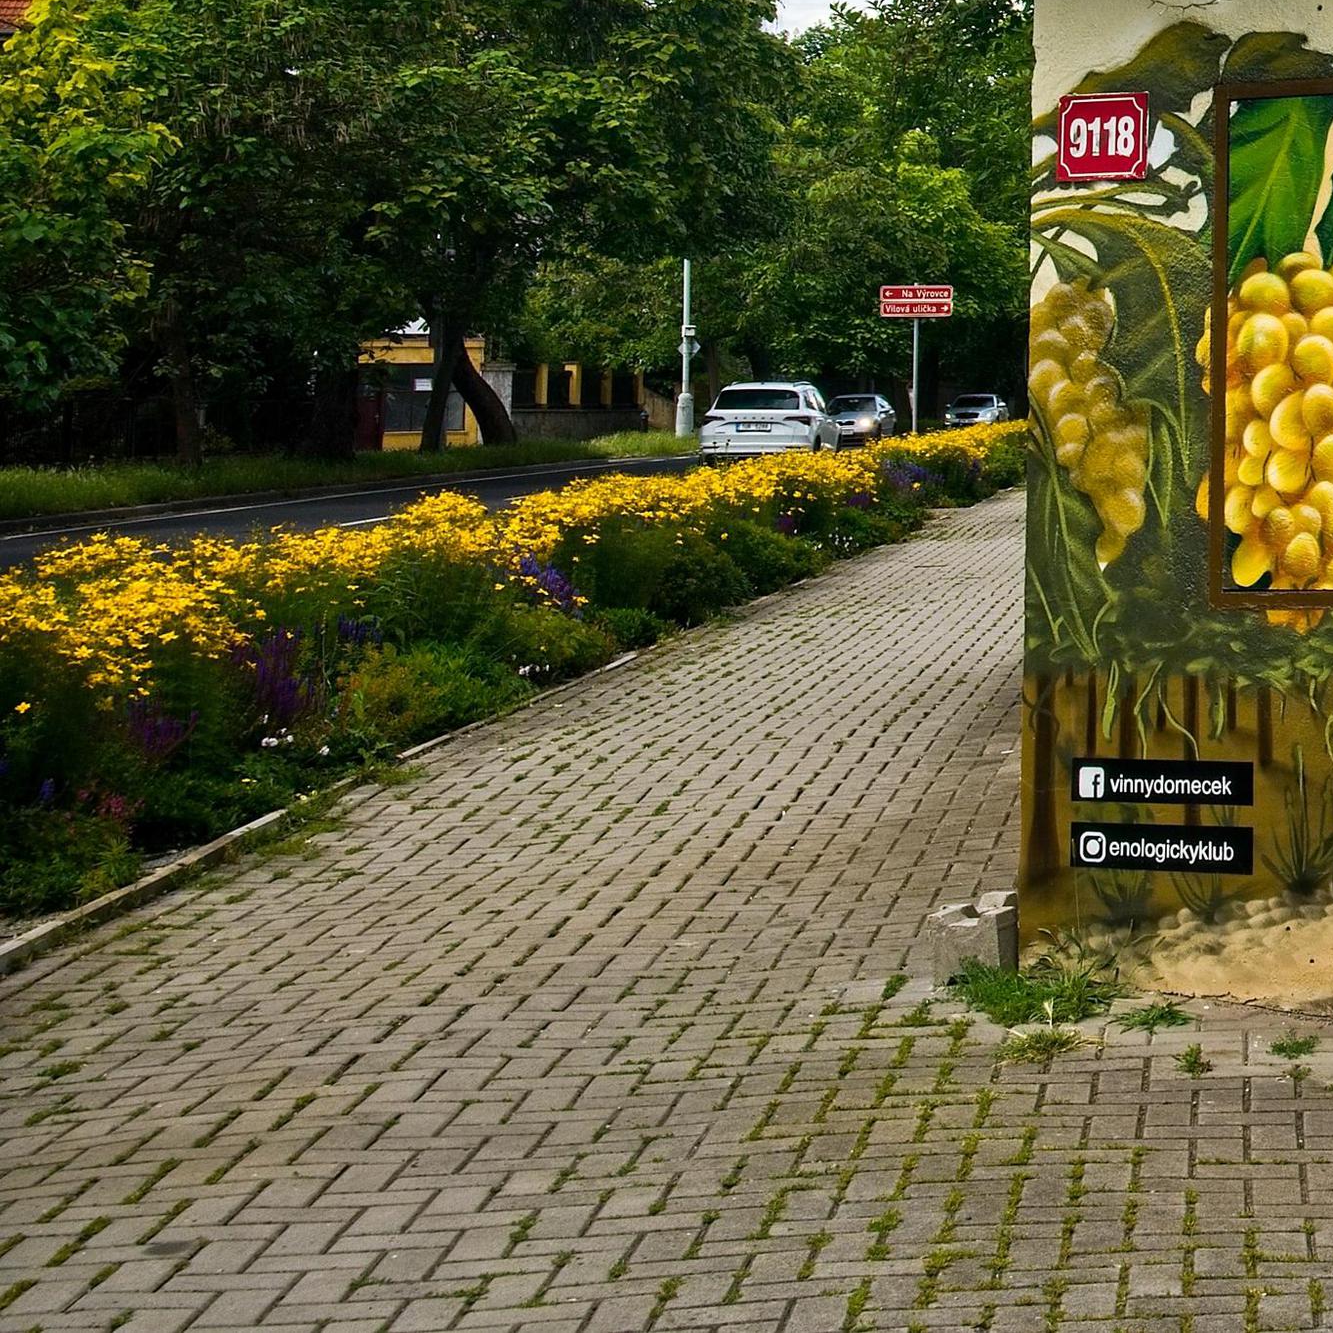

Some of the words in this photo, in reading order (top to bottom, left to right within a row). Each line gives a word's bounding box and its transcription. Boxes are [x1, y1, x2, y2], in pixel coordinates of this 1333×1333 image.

[1069, 115, 1135, 158] 9118
[901, 290, 913, 298] Na
[916, 289, 949, 299] Výrovce
[885, 304, 910, 313] Vilová
[912, 304, 937, 313] ulička
[1109, 774, 1232, 798] vinnydomecek
[1109, 838, 1234, 865] enologickyklub
